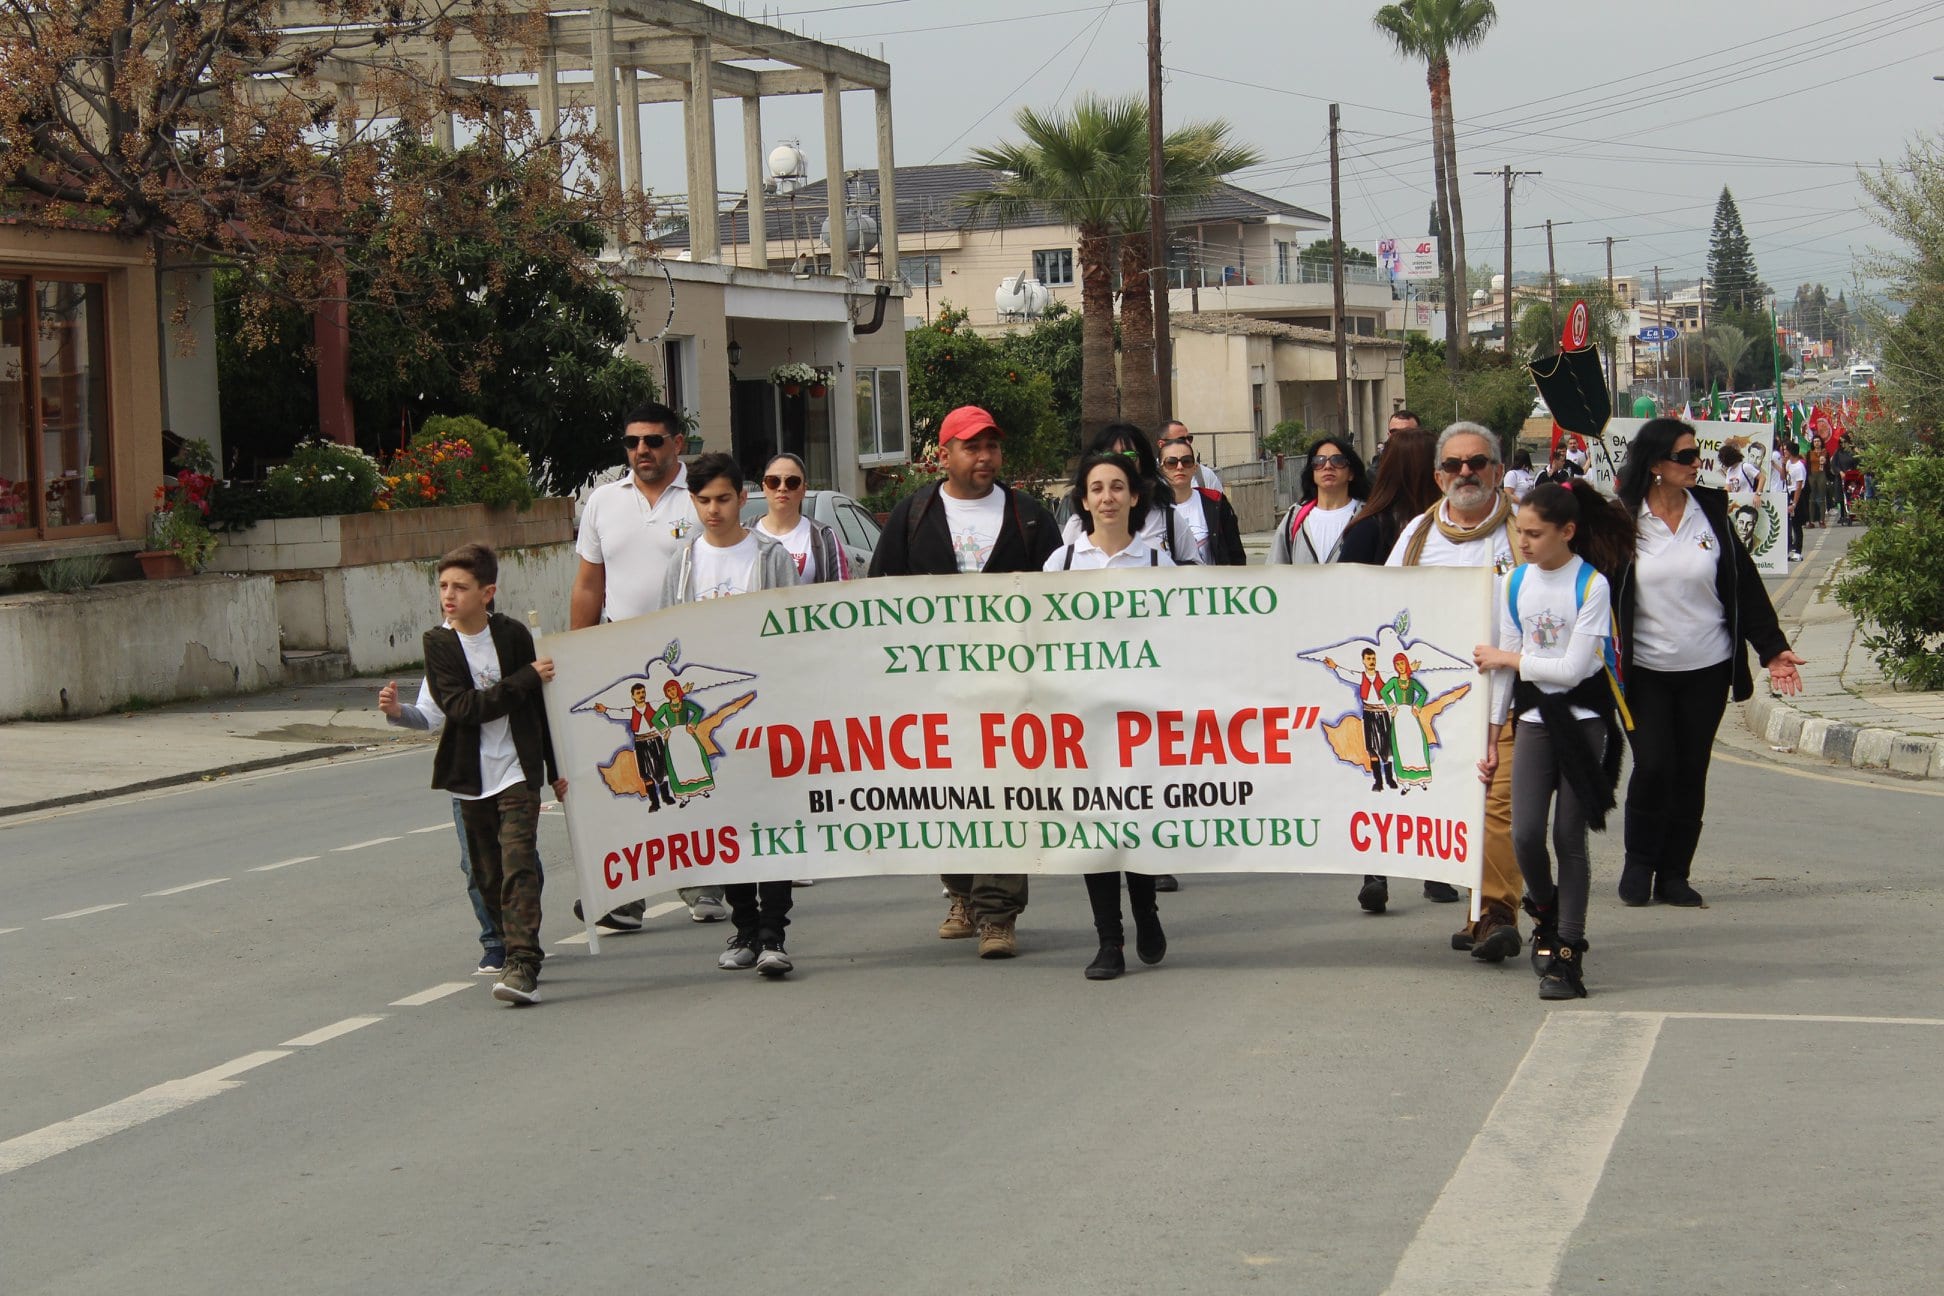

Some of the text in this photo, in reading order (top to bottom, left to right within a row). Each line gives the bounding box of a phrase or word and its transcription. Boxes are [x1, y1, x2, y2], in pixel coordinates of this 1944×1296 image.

[1415, 242, 1431, 254] 4G
[1612, 436, 1627, 446] ΘΑ
[1696, 438, 1722, 451] ΥΜΕ
[1699, 458, 1714, 472] ΥΝ
[760, 585, 1278, 637] ΔΙΚΟΙΝΟΤΙΚΟ ΧΟΡΕΥΤΙΚΟ
[883, 640, 1161, 674] ΣΥΓΚΡΟΤΗΜΑ
[735, 706, 1321, 778] “DANCE FOR PEACE”
[1003, 787, 1064, 811] FOLK
[1072, 785, 1154, 811] DANCE
[1163, 781, 1254, 809] GROUP
[817, 821, 1029, 853] TOPLUMLU
[1041, 821, 1141, 850] DANS
[1152, 817, 1321, 849] GURUBU
[1349, 810, 1468, 863] CYPRUS
[603, 826, 741, 890] CYPRUS
